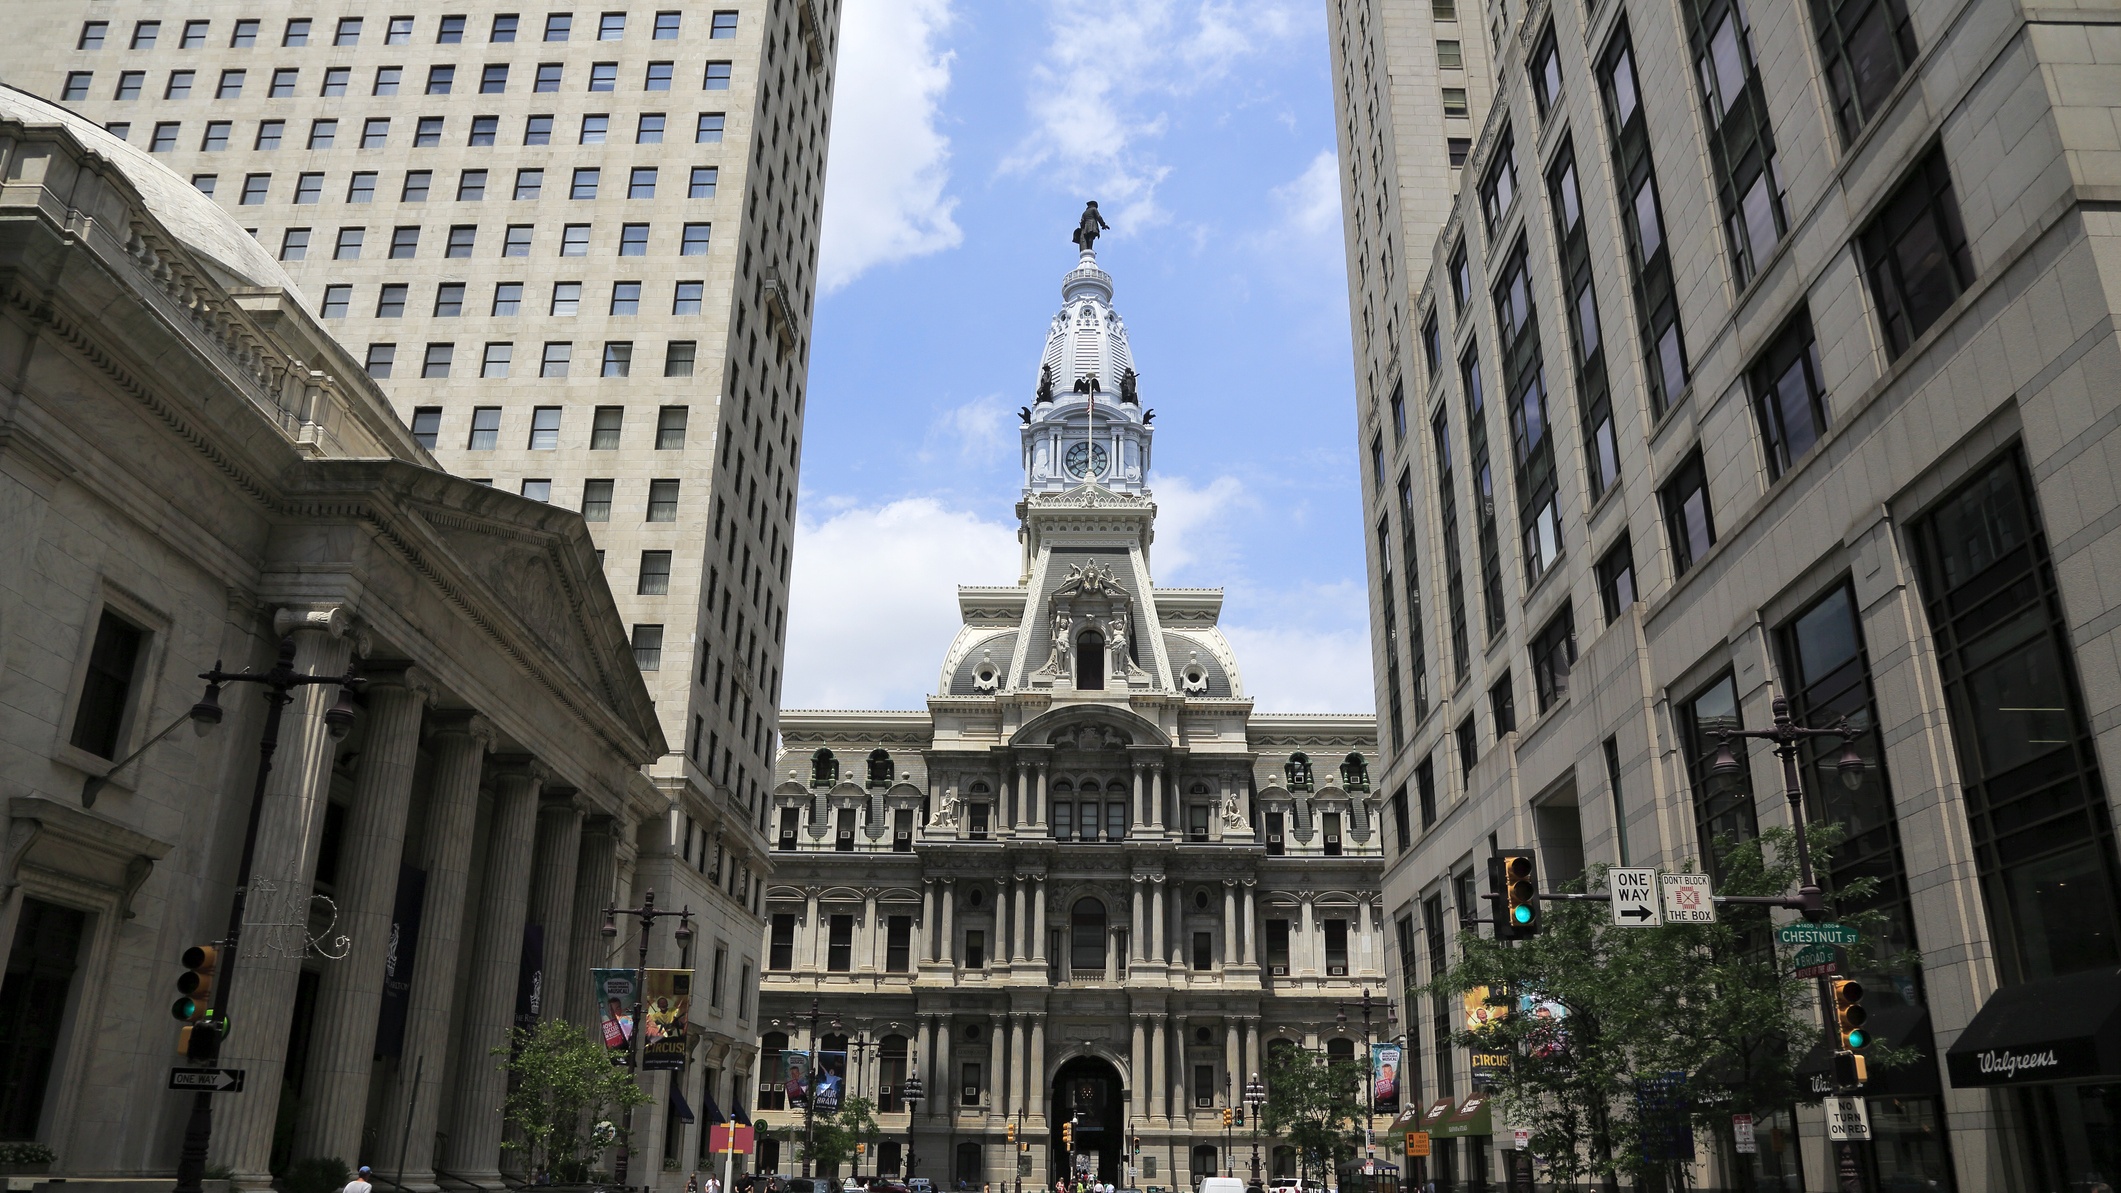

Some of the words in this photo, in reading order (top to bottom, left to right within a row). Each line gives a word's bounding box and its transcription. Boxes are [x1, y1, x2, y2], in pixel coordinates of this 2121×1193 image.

[1618, 873, 1648, 886] ONE
[1684, 876, 1708, 886] BLOCK
[1618, 888, 1650, 901] WAY
[1669, 910, 1688, 920] THE
[1691, 910, 1712, 921] BOX
[1782, 930, 1842, 943] CHESTNUT
[1846, 934, 1857, 943] ST
[1801, 951, 1826, 967] BROAD
[1827, 952, 1834, 962] ST
[644, 1042, 686, 1056] CIRCUS!
[1977, 1049, 2058, 1078] Walgreens
[176, 1074, 195, 1083] ONE
[198, 1075, 218, 1084] WAY
[816, 1096, 838, 1105] BRAIN
[1839, 1102, 1853, 1111] NO
[1833, 1113, 1862, 1122] TURN
[1831, 1125, 1846, 1134] ON
[1848, 1125, 1868, 1133] RED
